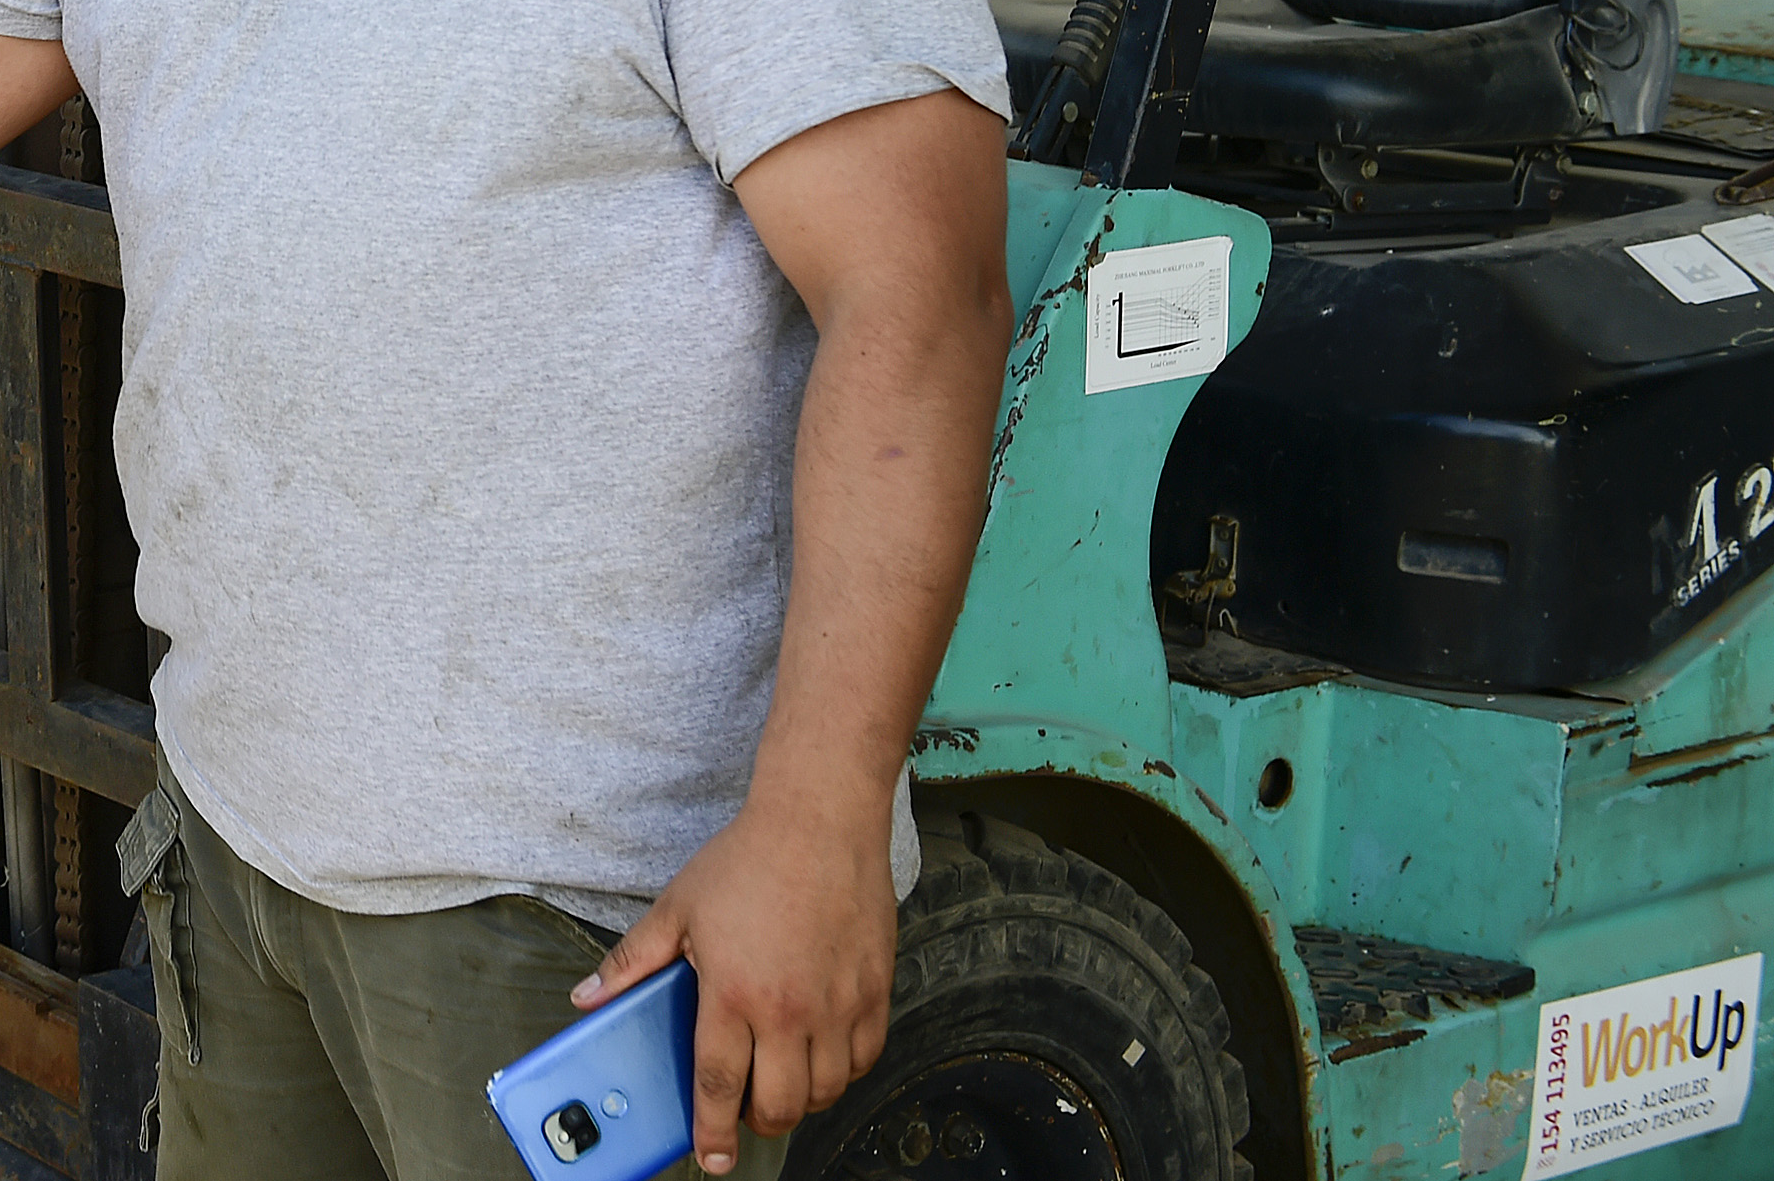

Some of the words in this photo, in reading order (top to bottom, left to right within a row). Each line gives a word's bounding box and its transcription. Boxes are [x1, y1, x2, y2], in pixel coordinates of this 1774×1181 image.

[1676, 537, 1741, 608] SERIES
[1545, 1013, 1571, 1104] 113495
[1581, 988, 1745, 1089] WorkUp
[1540, 1110, 1562, 1155] 154
[1572, 1099, 1629, 1128] VENTAS
[1639, 1076, 1710, 1111] ALQUILER
[1569, 1137, 1580, 1154] Y
[1580, 1117, 1649, 1151] SERVICIO
